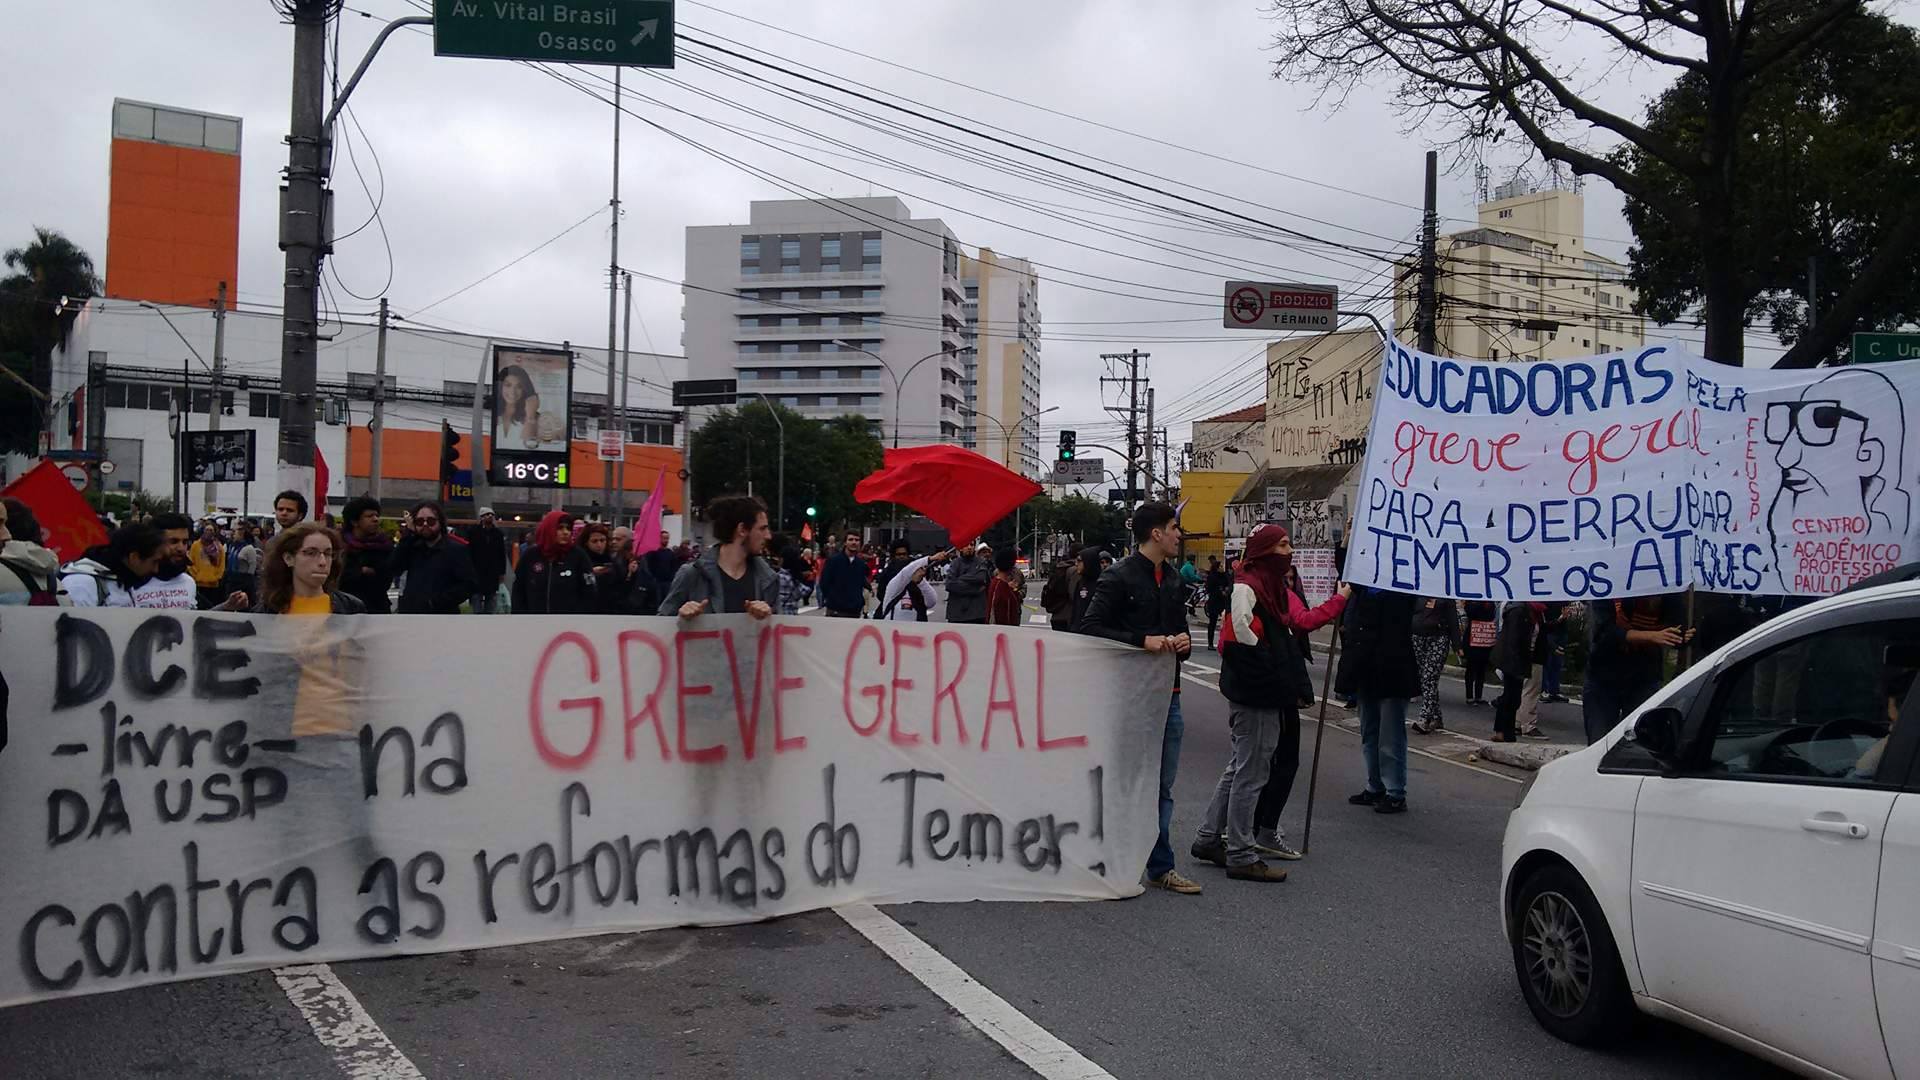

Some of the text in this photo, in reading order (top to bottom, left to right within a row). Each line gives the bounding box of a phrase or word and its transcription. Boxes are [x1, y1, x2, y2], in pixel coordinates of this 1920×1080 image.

[452, 0, 616, 26] Av. Vital Brasil
[538, 31, 617, 52] Osasco
[1273, 293, 1329, 306] RODÍZIO
[1272, 313, 1329, 325] TÉRMINO
[1385, 345, 1674, 416] EDUCADORAS
[1687, 369, 1748, 413] PELA
[1391, 420, 1532, 488] greve
[1562, 407, 1711, 496] geral
[504, 463, 549, 480] 16°C
[451, 483, 473, 497] Ita
[1367, 477, 1469, 542] PARA
[1507, 482, 1732, 543] DERRUBAR
[1792, 516, 1866, 535] CENTRO
[1367, 526, 1514, 599] TEMER
[1529, 565, 1553, 596] E
[1562, 561, 1613, 598] OS
[1793, 537, 1902, 562] ACADÊMICO
[1794, 574, 1841, 593] PAULO
[52, 611, 263, 712] DCE
[358, 623, 1089, 799] na GREVE GERAL
[46, 765, 290, 848] DA USP
[18, 762, 1107, 991] contra as reformas do Temer!
